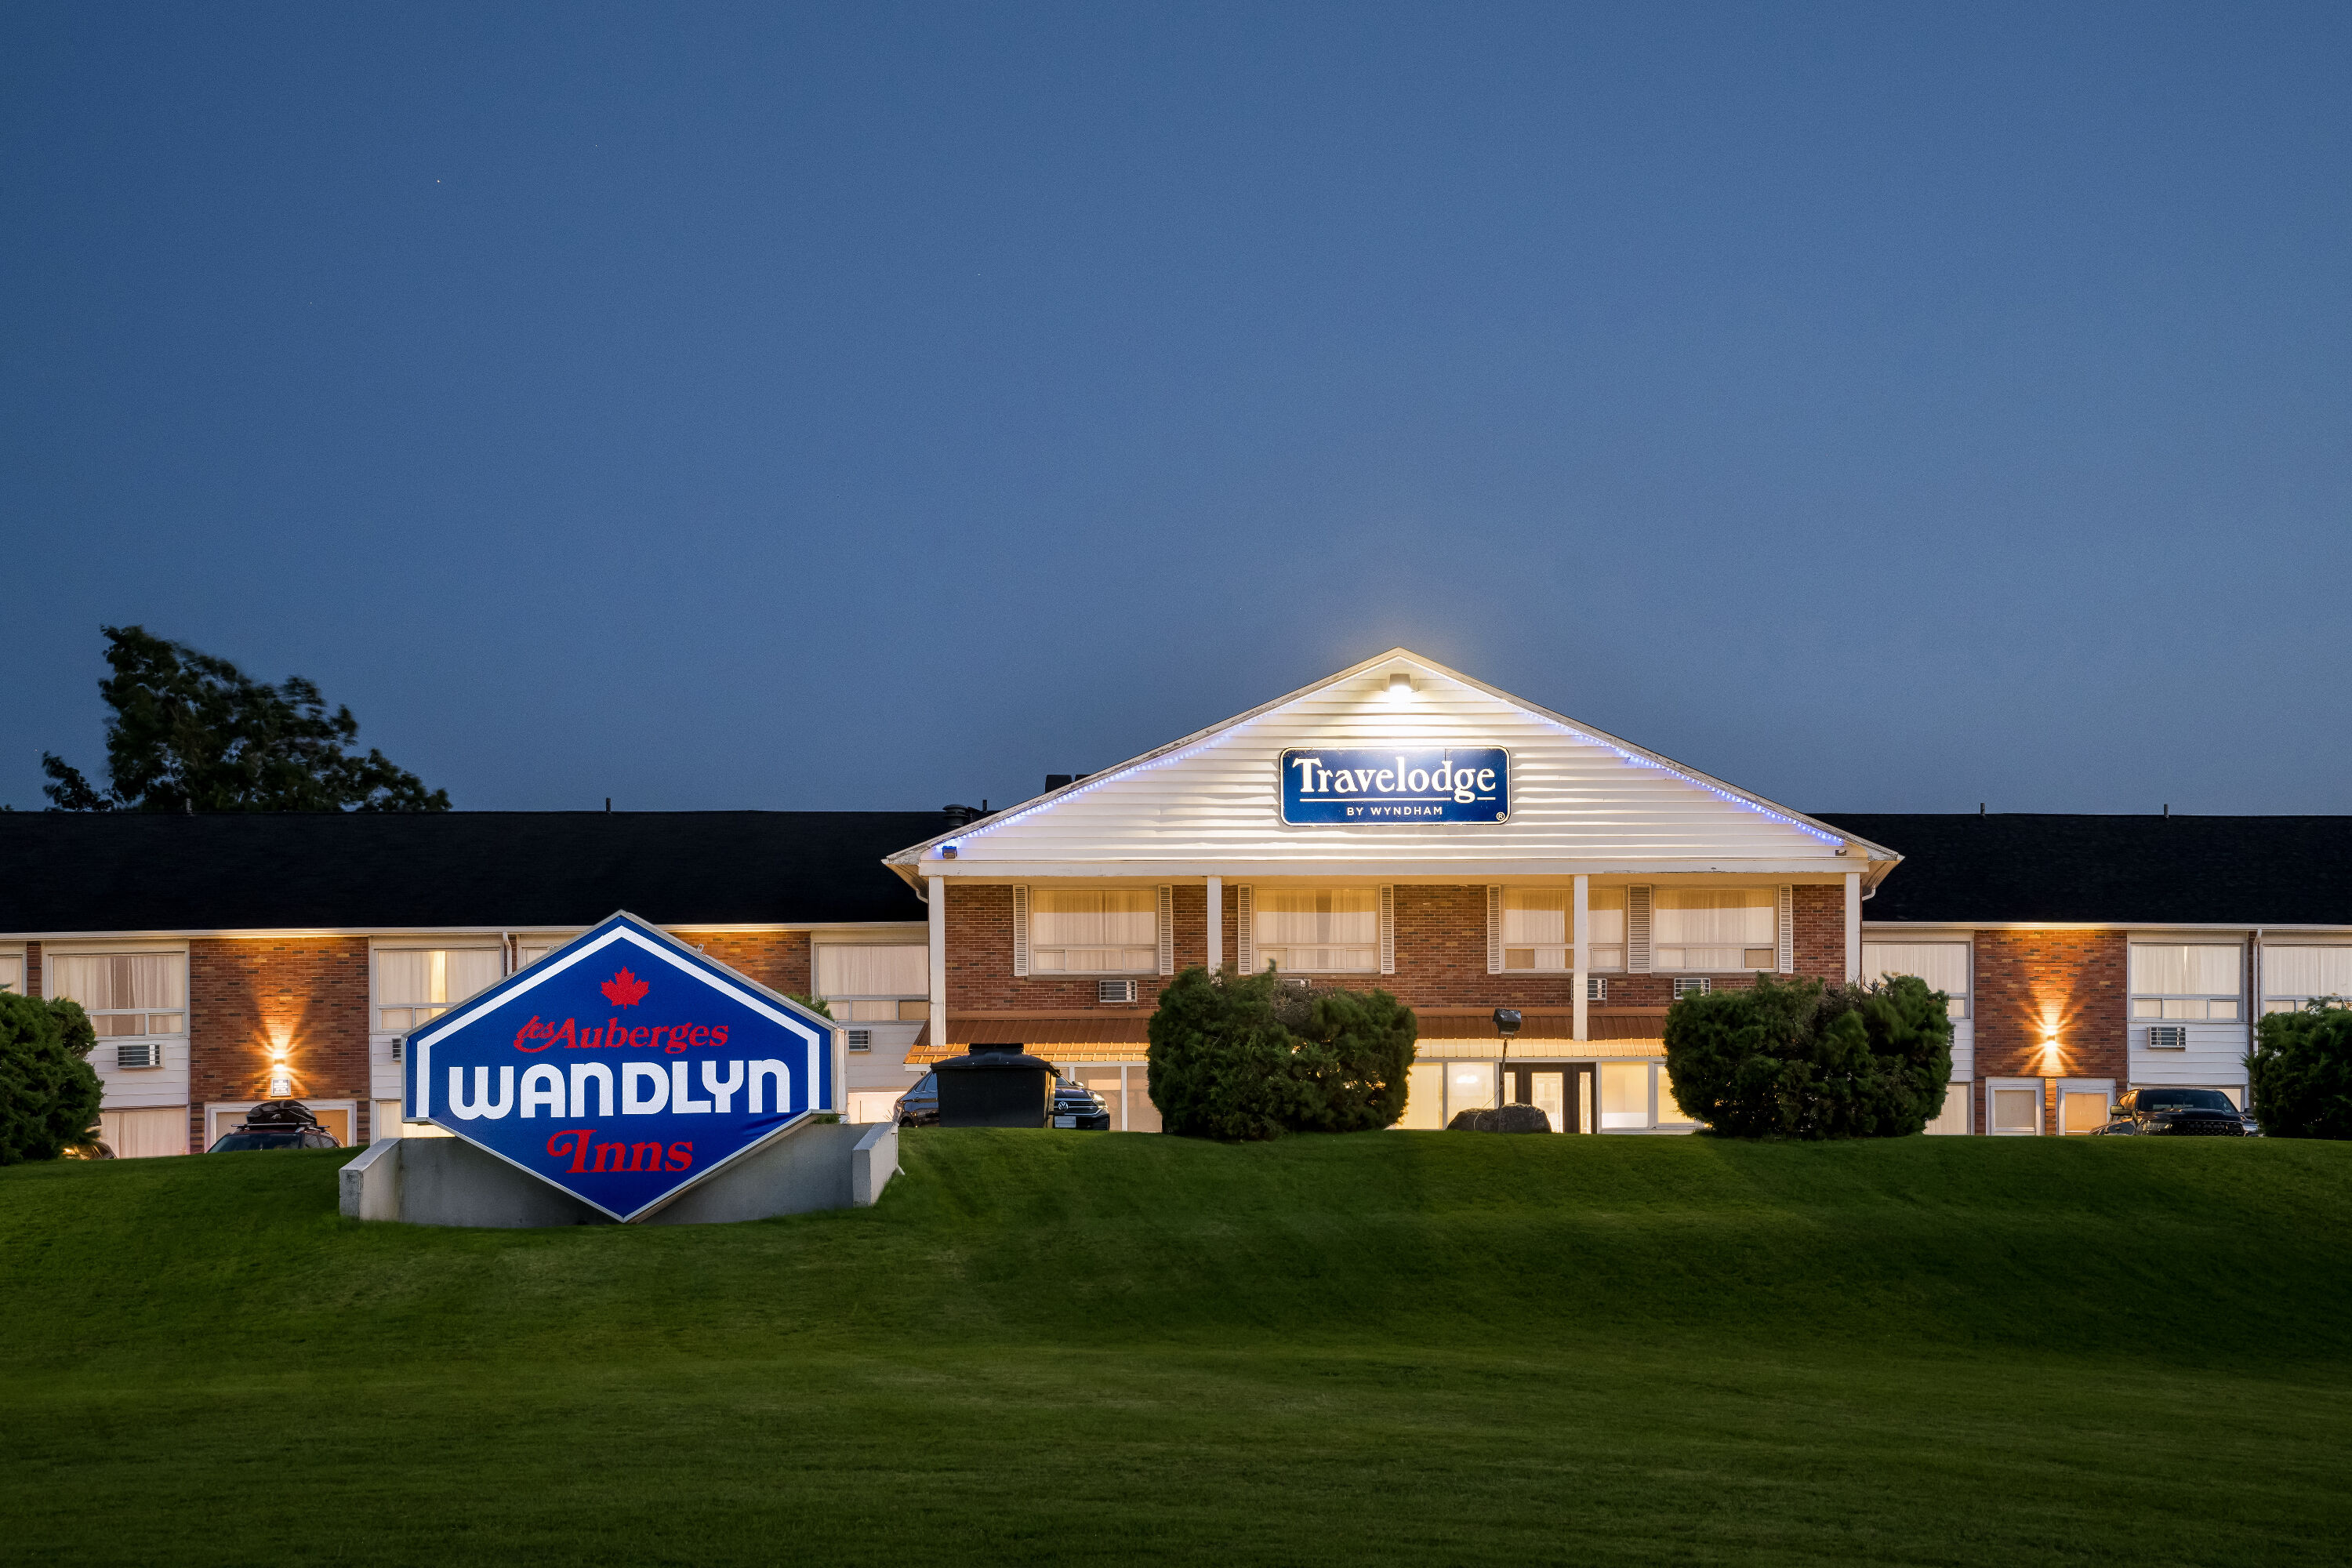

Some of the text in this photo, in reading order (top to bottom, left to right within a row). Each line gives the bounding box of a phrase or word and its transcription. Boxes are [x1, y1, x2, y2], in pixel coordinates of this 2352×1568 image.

[1292, 757, 1496, 804] Travelodge
[1346, 806, 1443, 816] BY WYNDHAM
[513, 1017, 729, 1054] Auberges
[448, 1058, 790, 1120] WANDLYN
[546, 1129, 693, 1174] Inns
